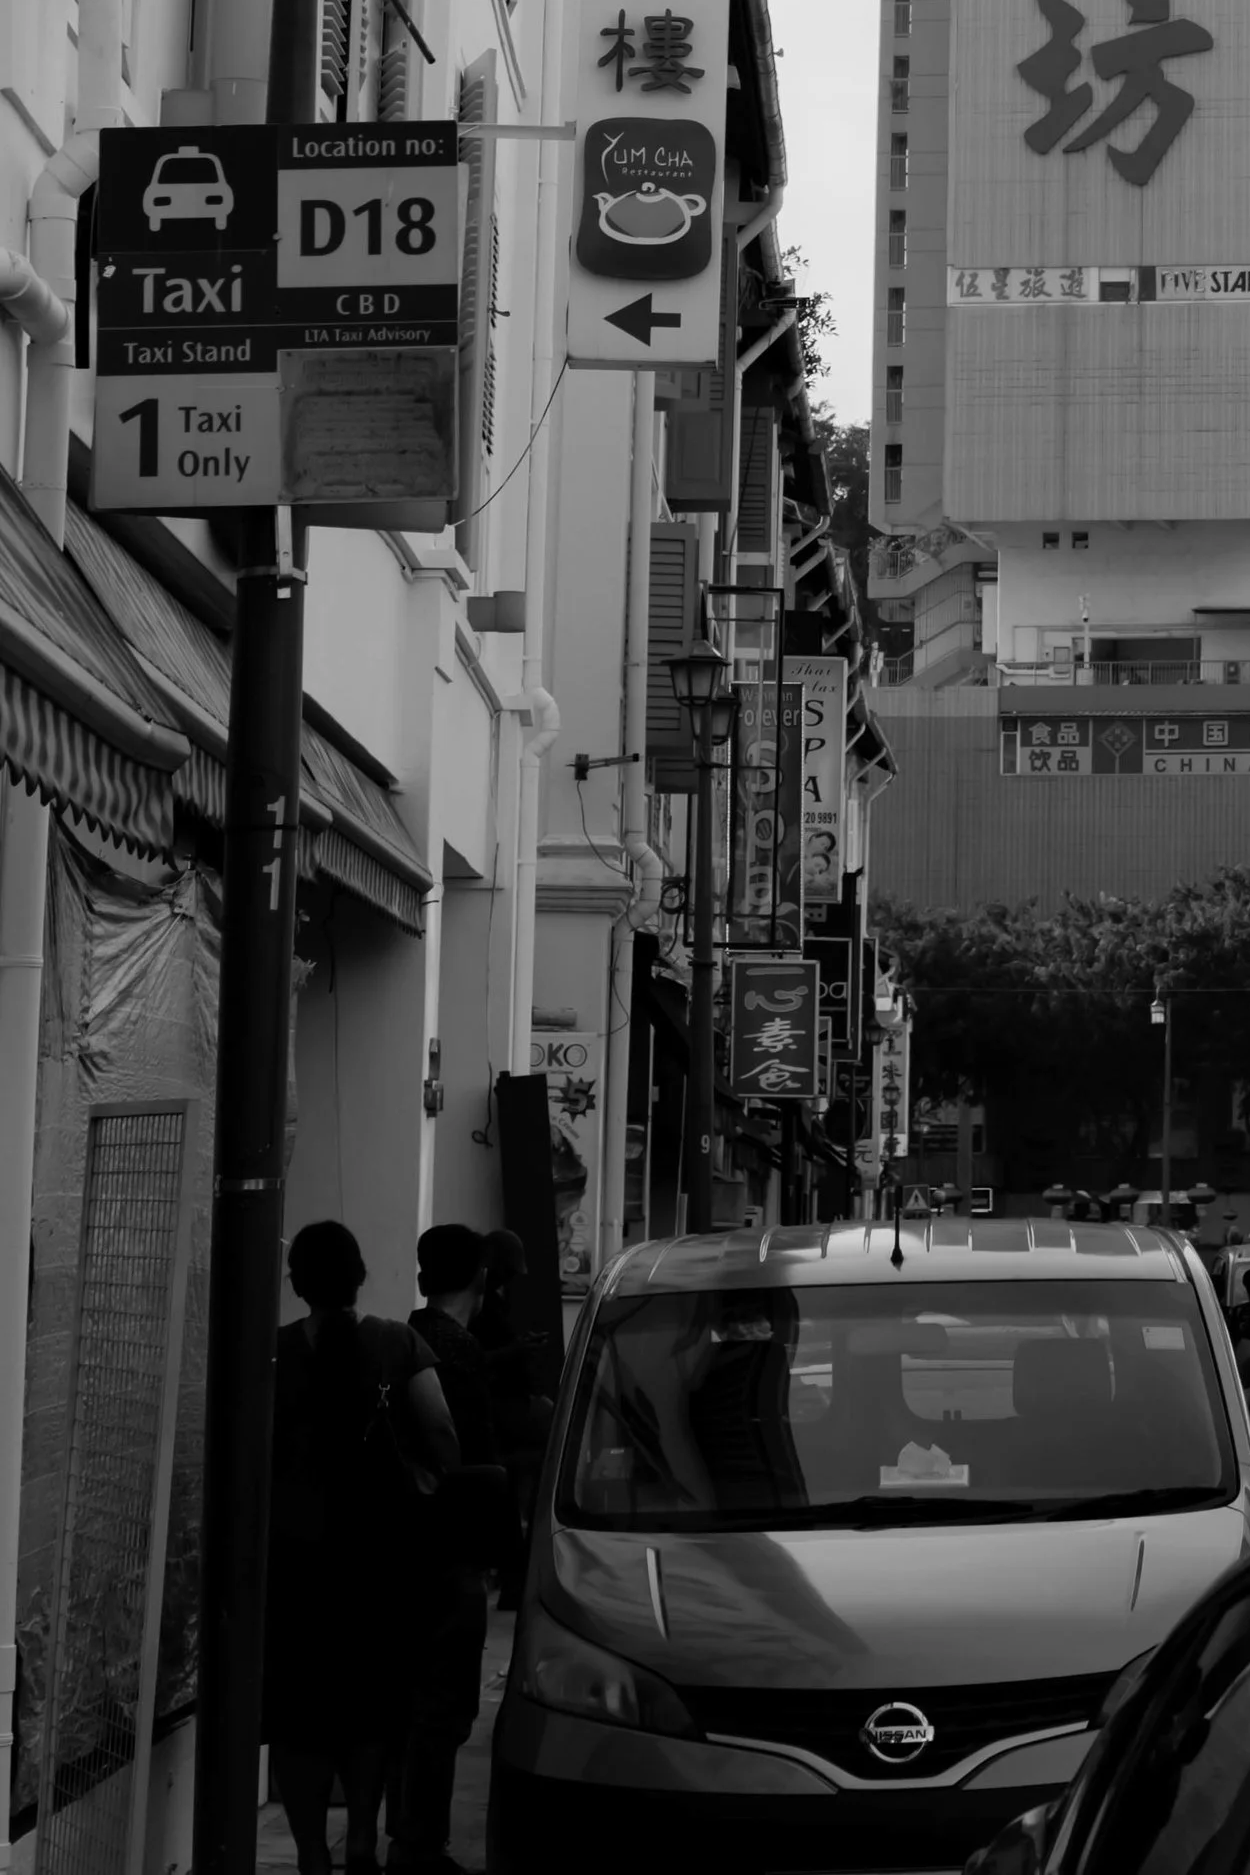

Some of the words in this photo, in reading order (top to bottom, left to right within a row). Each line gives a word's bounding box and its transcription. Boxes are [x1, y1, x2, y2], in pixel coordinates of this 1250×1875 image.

[292, 134, 397, 159] Location
[405, 136, 445, 156] no:
[299, 197, 437, 258] D18
[132, 264, 243, 314] Taxi
[304, 329, 329, 343] LTA
[333, 327, 363, 342] Taxi
[367, 325, 431, 345] Advisory
[124, 341, 173, 365] Taxi
[182, 339, 251, 364] Stand
[178, 404, 242, 433] Taxi
[118, 397, 160, 478] 1
[177, 447, 250, 483] Only
[1028, 722, 1080, 746] 食品
[1028, 749, 1080, 774] 饮品
